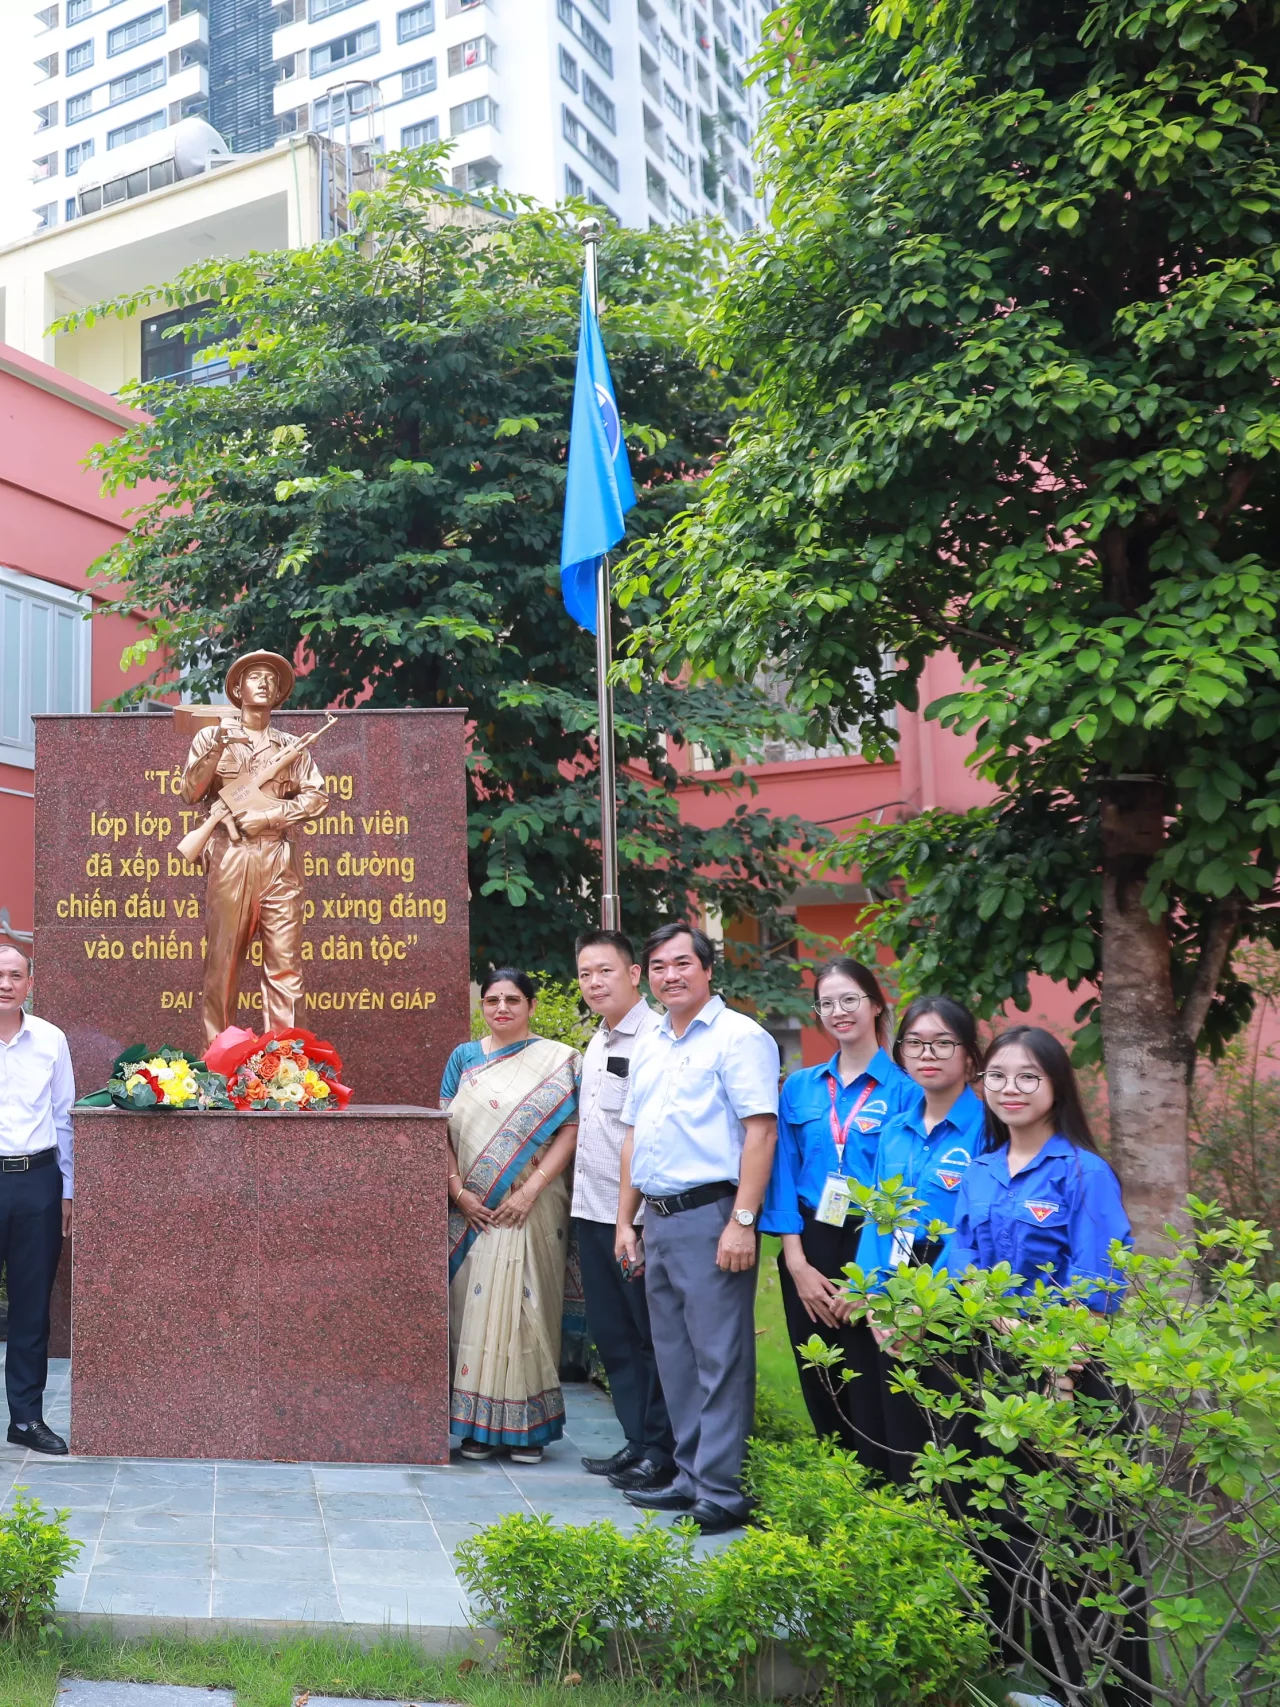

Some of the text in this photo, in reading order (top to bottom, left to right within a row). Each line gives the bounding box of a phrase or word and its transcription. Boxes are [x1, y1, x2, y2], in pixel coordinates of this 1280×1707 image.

[90, 811, 128, 842] lớp
[135, 811, 172, 842] lớp
[361, 809, 409, 835] viên
[86, 852, 113, 877] đã
[119, 846, 160, 883] xếp
[303, 851, 329, 877] ên
[336, 850, 415, 883] đường
[56, 887, 117, 919] chiến
[124, 887, 166, 919] đấu
[173, 893, 199, 919] và
[321, 892, 382, 925] xứng
[389, 892, 447, 925] đáng
[84, 934, 125, 960] vào
[131, 929, 193, 960] chiến
[321, 934, 363, 960] dân
[161, 991, 193, 1014] ĐẠI
[305, 987, 385, 1010] NGUYÊN
[390, 987, 437, 1010] GIÁP
